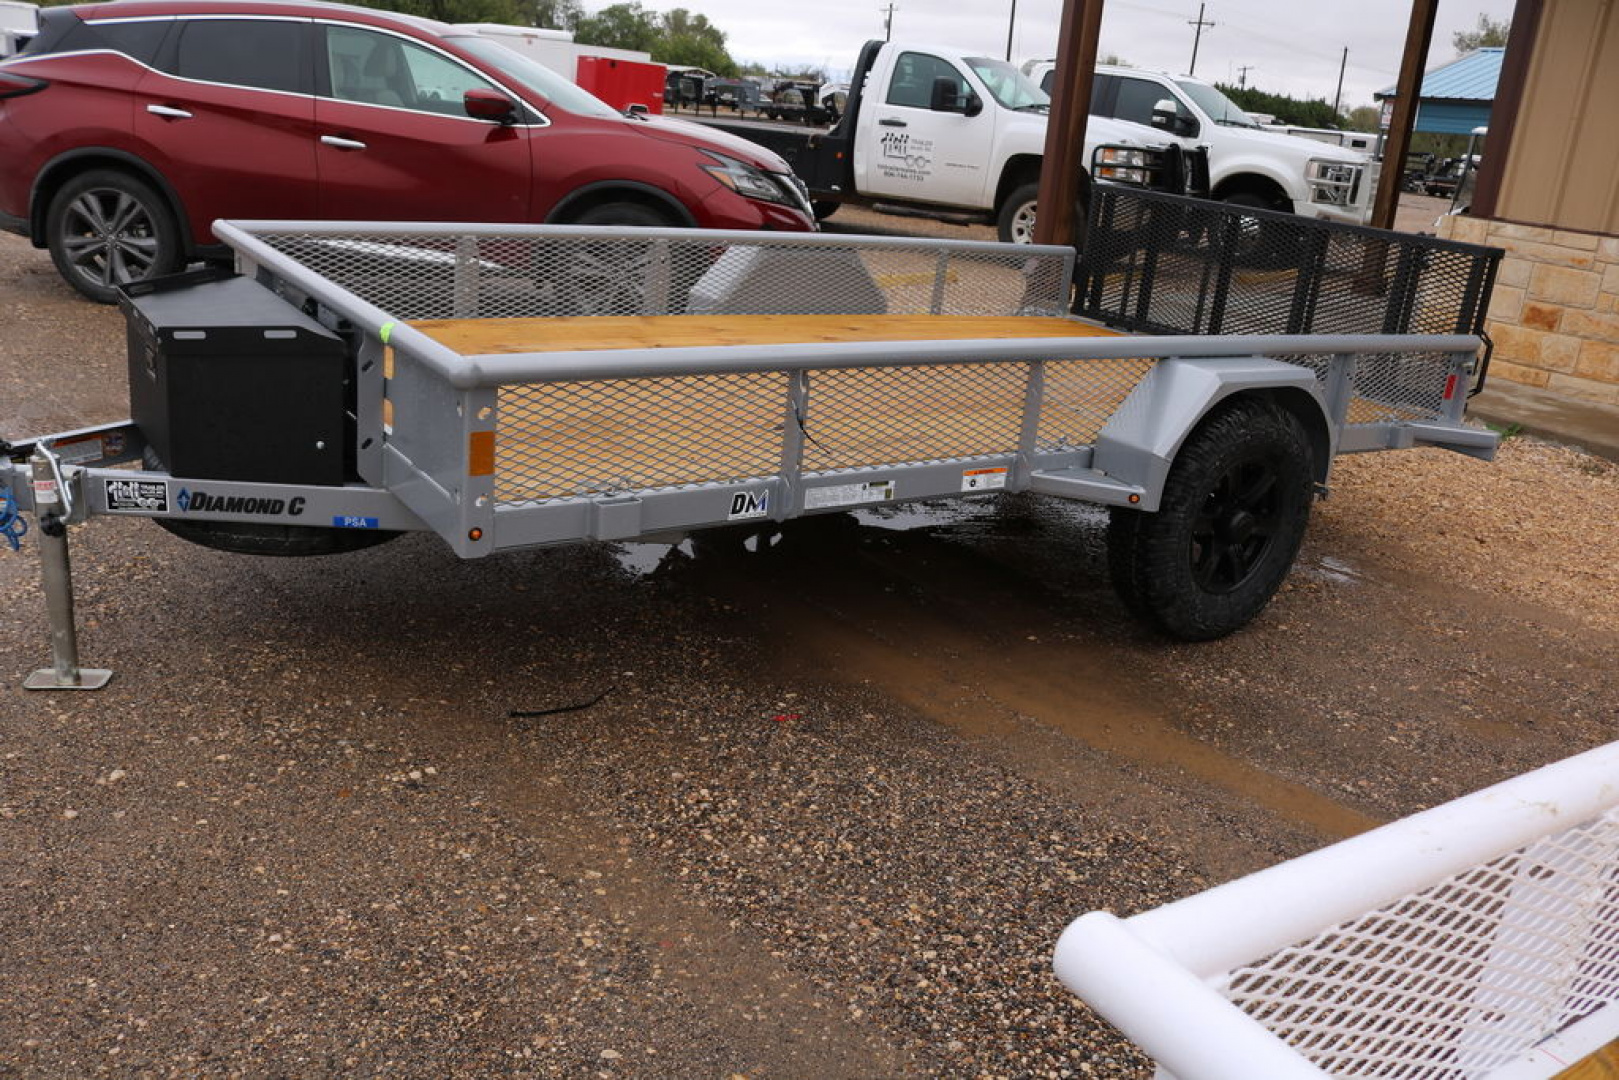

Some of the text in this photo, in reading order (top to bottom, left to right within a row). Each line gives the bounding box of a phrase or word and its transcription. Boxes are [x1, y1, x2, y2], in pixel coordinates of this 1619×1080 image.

[189, 491, 306, 516] DIAMOND C
[343, 516, 367, 528] PSA
